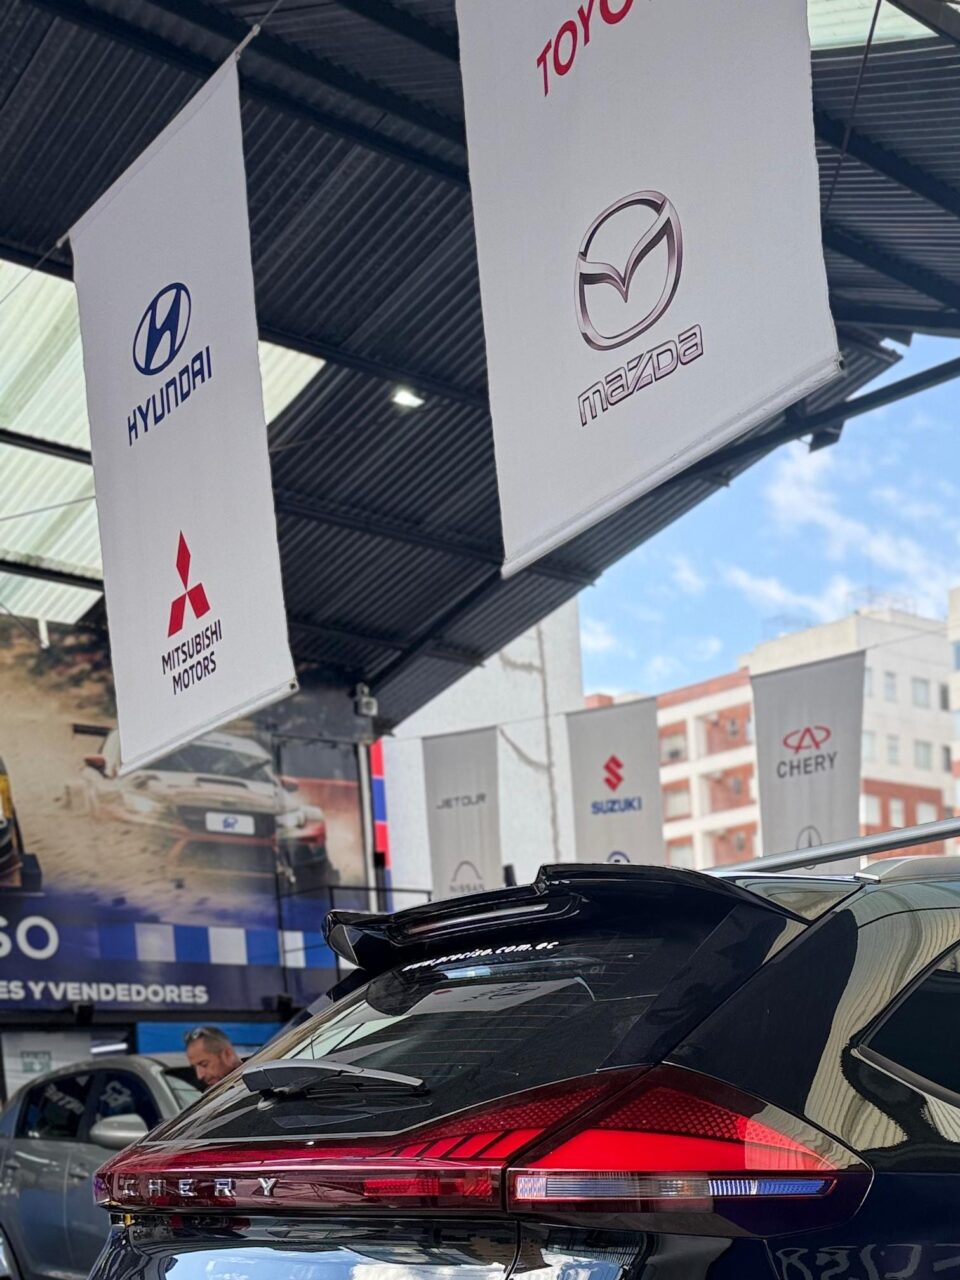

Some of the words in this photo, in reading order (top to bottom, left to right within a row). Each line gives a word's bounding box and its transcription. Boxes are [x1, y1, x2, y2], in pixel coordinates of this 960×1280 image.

[127, 345, 213, 447] HYUNDAI
[161, 618, 223, 676] MITSUBISHI
[172, 650, 217, 696] MOTORS
[776, 751, 838, 779] CHERY
[435, 793, 487, 810] JETOUR
[590, 796, 643, 815] SUZUKI
[401, 941, 560, 972] www.preciso.com.ec
[27, 980, 46, 1001] Y
[47, 981, 210, 1005] VENDEDORES
[122, 1177, 280, 1198] CHERY
